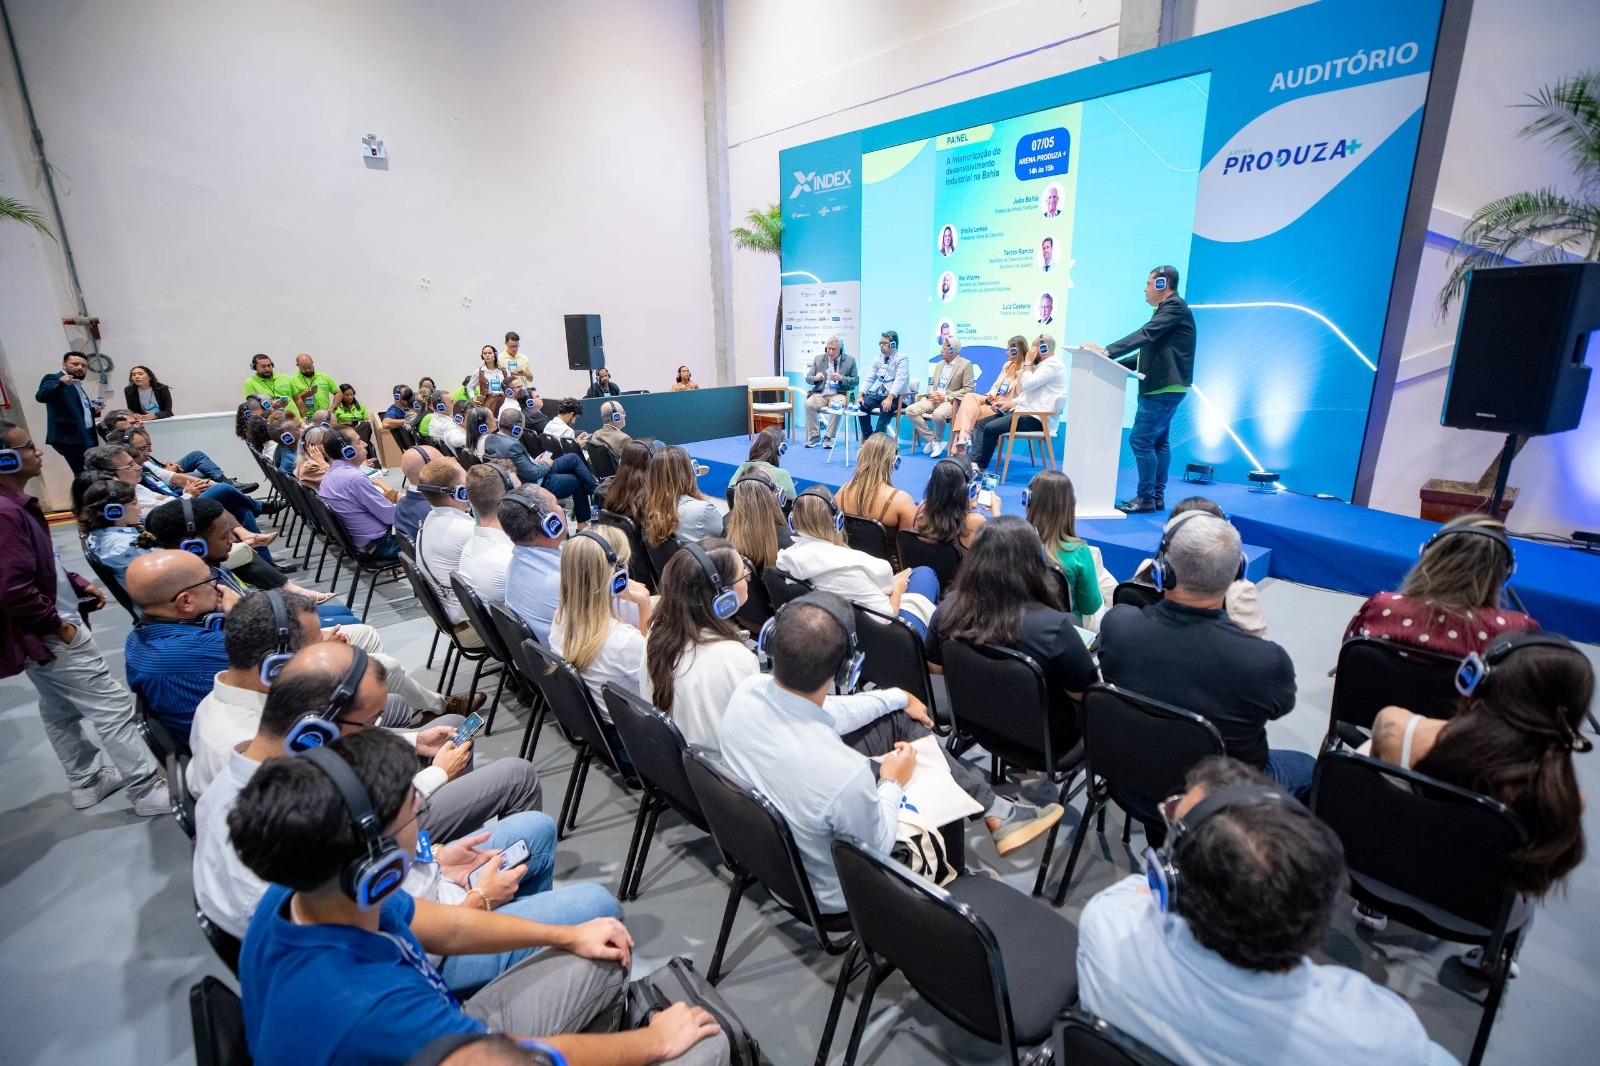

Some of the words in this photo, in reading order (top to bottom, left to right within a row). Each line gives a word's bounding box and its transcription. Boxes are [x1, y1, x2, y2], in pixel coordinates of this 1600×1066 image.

[1269, 41, 1419, 93] AUDITÓRIO
[947, 134, 968, 145] PAINEL
[1032, 136, 1055, 151] 07/05
[946, 157, 951, 165] A
[952, 148, 992, 165] interiorização
[992, 147, 1001, 156] do
[1018, 156, 1036, 165] ARENA
[1036, 151, 1062, 162] PRODUZA
[946, 160, 996, 176] desenvolvimento
[1029, 167, 1038, 175] 14h
[1045, 164, 1055, 172] 15h
[946, 175, 972, 186] industrial
[982, 170, 1000, 180] Bahia
[1014, 197, 1025, 205] João
[1025, 195, 1039, 203] Bahia
